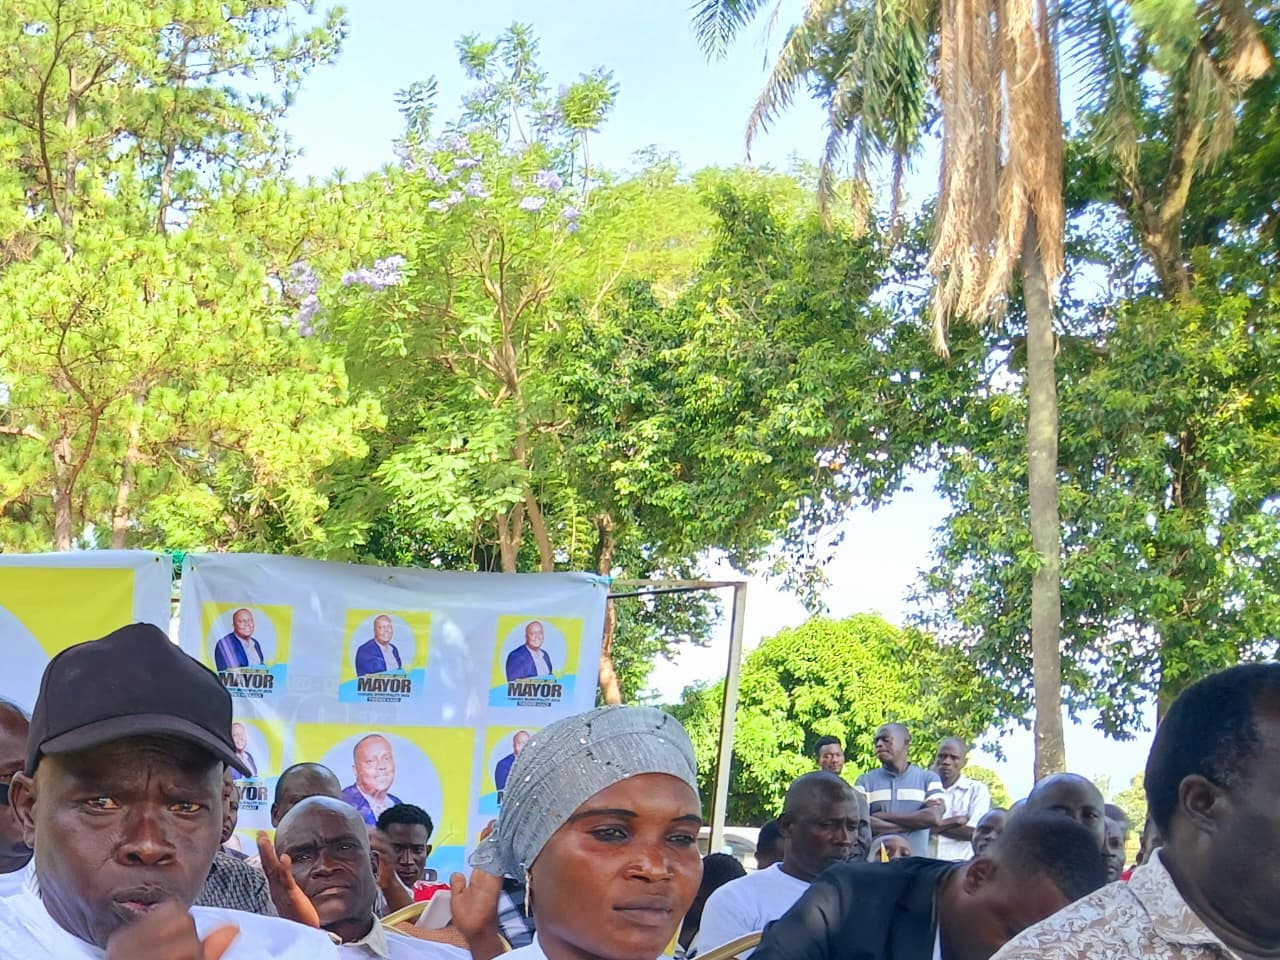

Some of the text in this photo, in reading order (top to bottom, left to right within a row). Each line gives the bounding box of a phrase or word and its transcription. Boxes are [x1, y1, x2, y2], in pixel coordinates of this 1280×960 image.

[219, 672, 274, 689] MAYOR
[357, 677, 412, 693] MAYOR
[507, 682, 562, 698] MAYOR
